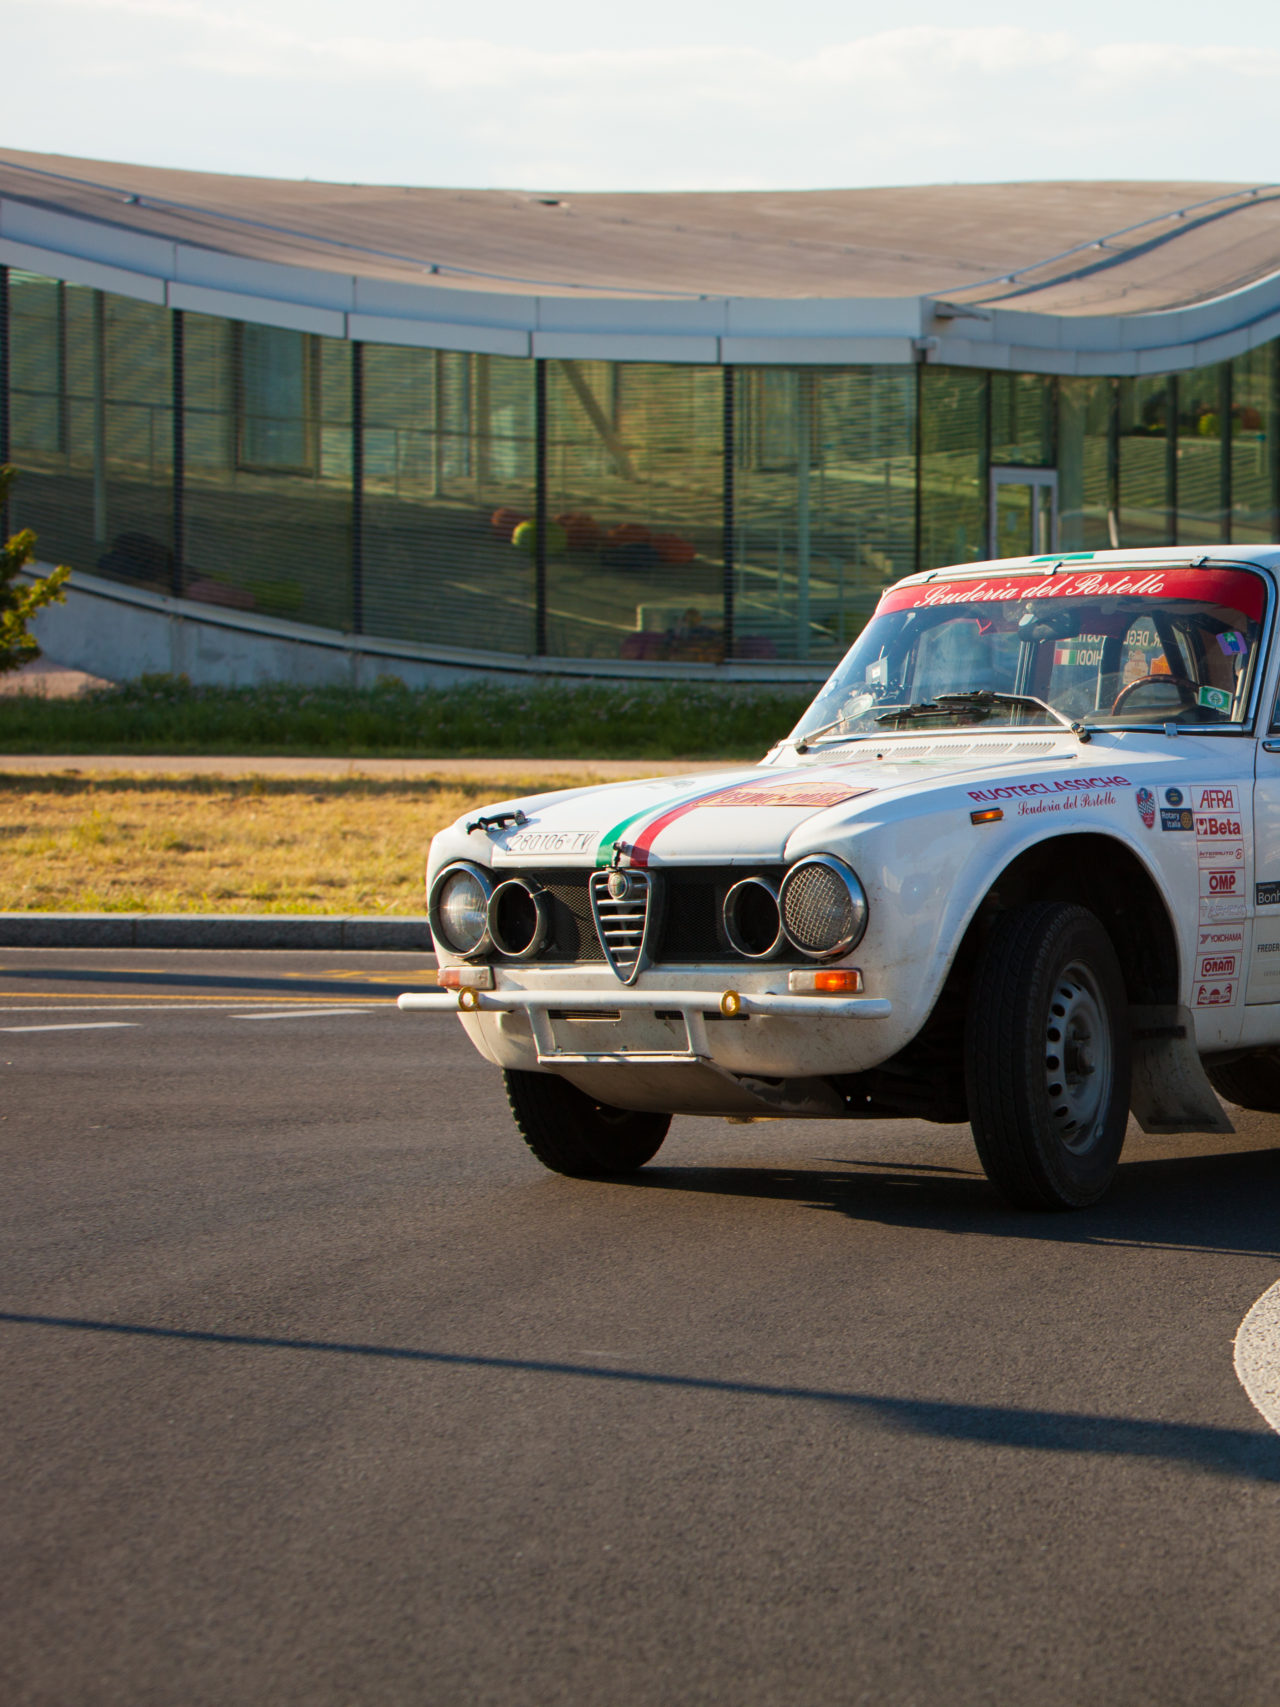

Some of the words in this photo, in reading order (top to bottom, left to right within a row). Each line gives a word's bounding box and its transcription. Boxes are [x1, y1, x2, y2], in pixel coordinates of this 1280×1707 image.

[914, 582, 1018, 608] Scuderia
[1019, 576, 1066, 600] del
[1065, 573, 1165, 596] Portello
[1017, 796, 1062, 816] Scuderia
[1063, 795, 1078, 810] del
[1080, 791, 1118, 808] Portello
[1200, 790, 1234, 808] AFRA
[1208, 818, 1241, 835] Beta
[1209, 874, 1236, 891] OMP
[1210, 933, 1241, 943] YOKOHAMA
[1204, 960, 1233, 973] ORAM
